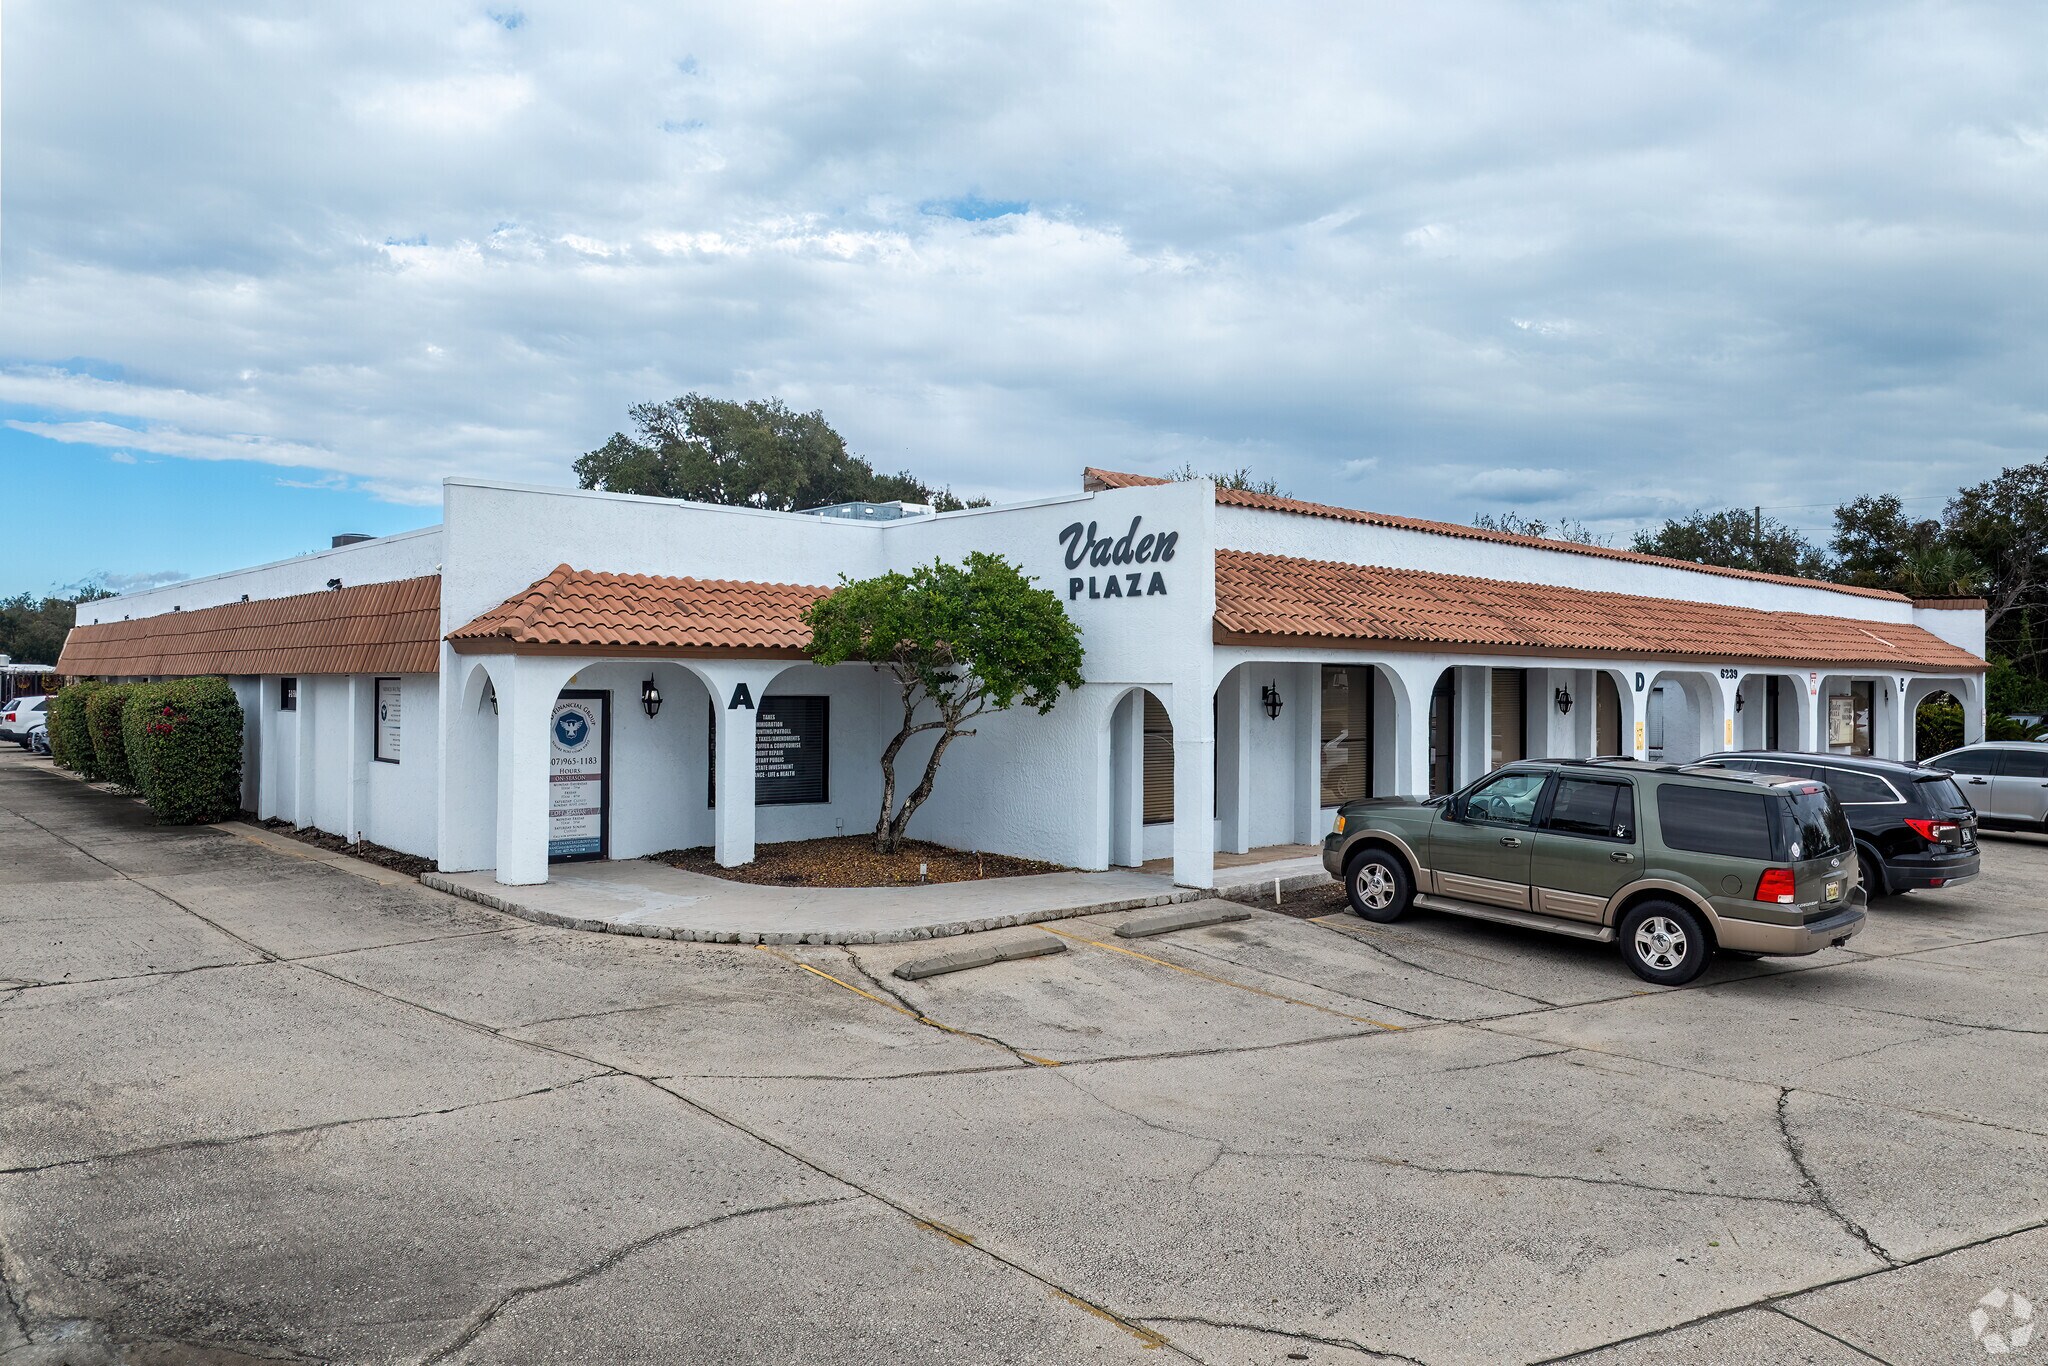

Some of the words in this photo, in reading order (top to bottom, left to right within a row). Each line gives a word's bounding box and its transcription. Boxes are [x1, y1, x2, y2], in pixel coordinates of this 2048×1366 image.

[1059, 515, 1179, 570] Vaden
[1069, 571, 1167, 600] PLAZA
[1635, 672, 1645, 692] D
[1720, 668, 1738, 680] 6239
[728, 683, 755, 709] A
[552, 702, 582, 715] FINANCIAL
[551, 756, 597, 766] 07)965-1183
